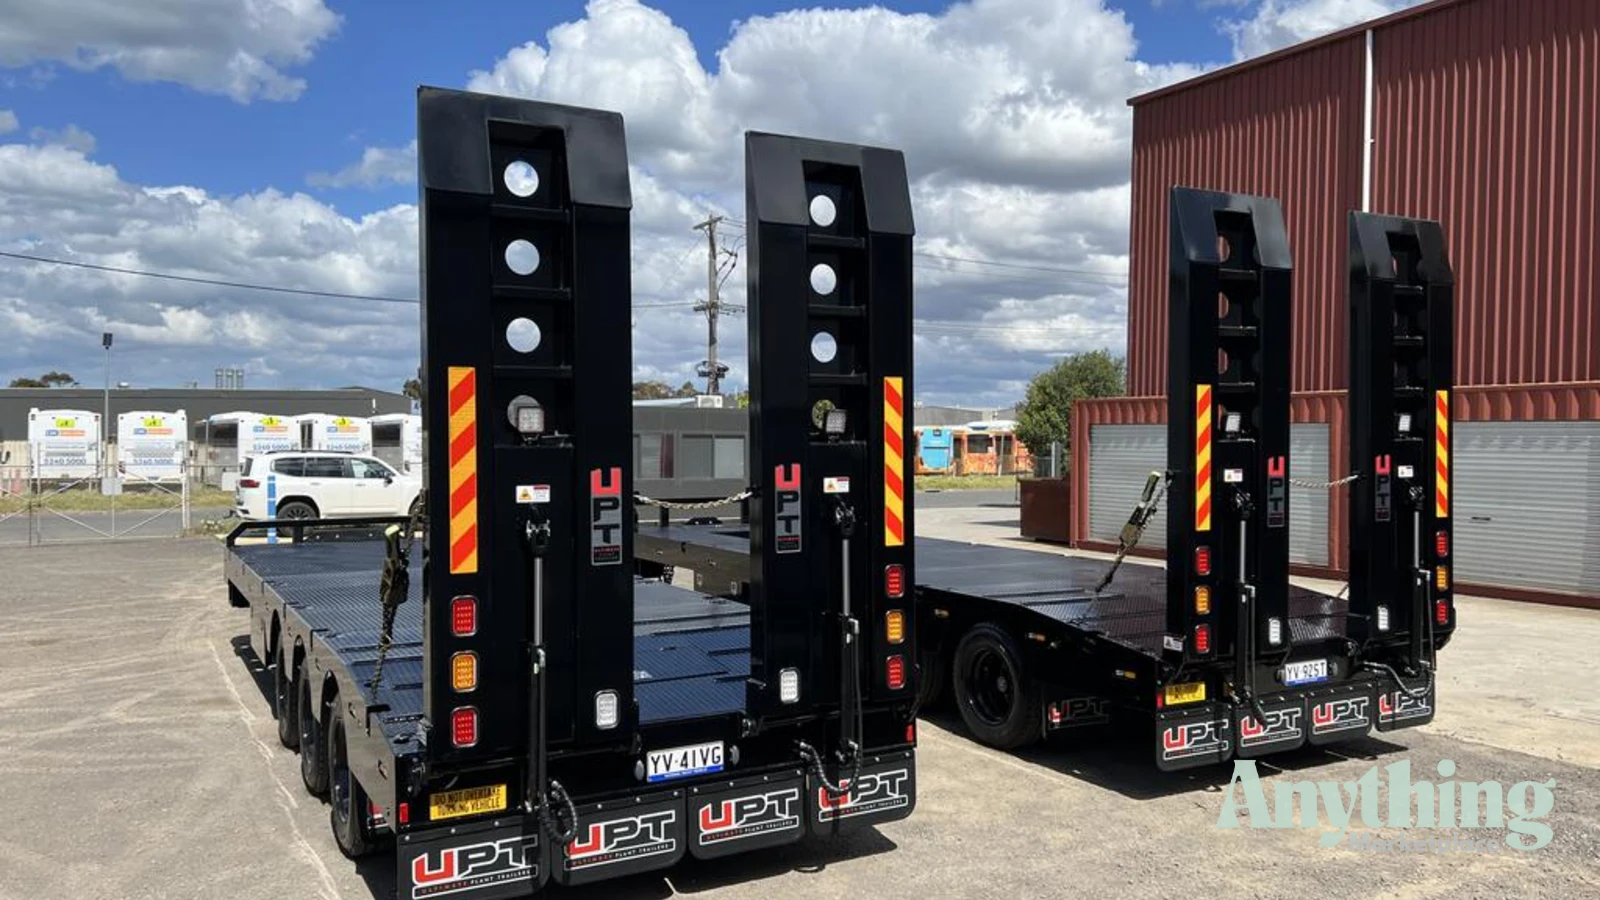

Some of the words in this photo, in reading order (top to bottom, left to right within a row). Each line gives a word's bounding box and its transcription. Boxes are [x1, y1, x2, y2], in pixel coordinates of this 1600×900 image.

[590, 467, 622, 544] UPT
[775, 463, 801, 533] UPT
[1268, 456, 1285, 511] UPT
[1242, 708, 1301, 739] UPT
[1313, 696, 1369, 727] UPT
[1164, 719, 1229, 752] UPT
[700, 788, 798, 833] UPT
[819, 769, 907, 811] UPT
[565, 809, 675, 859] UPT
[412, 834, 538, 886] UPT
